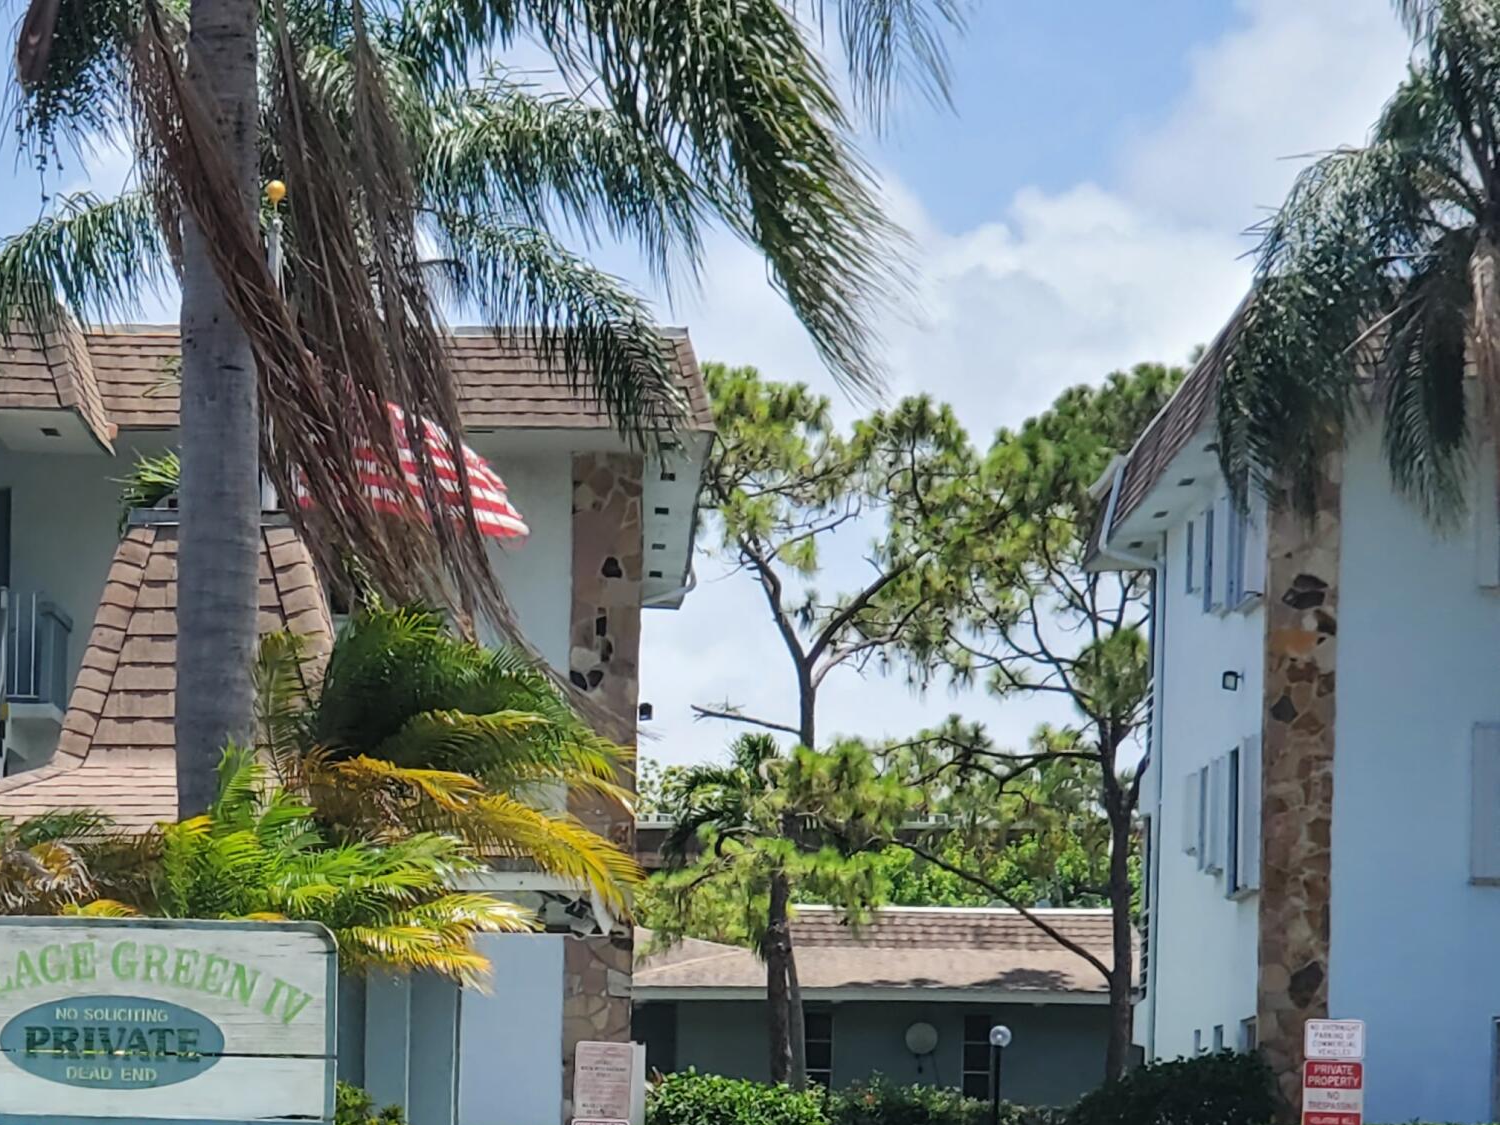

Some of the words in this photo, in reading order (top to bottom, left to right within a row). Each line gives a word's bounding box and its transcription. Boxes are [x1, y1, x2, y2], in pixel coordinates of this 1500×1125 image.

[110, 940, 260, 1008] GREEN
[262, 976, 314, 1025] IV
[55, 1007, 78, 1020] NO
[84, 1008, 169, 1023] SOLICITING
[1314, 1032, 1345, 1040] PARKING
[25, 1025, 201, 1063] PRIVATE
[66, 1066, 112, 1081] DEAD
[120, 1067, 158, 1082] END
[1314, 1064, 1354, 1076] PRIVATE
[1307, 1075, 1360, 1087] PROPERTY
[1327, 1091, 1340, 1101] NO
